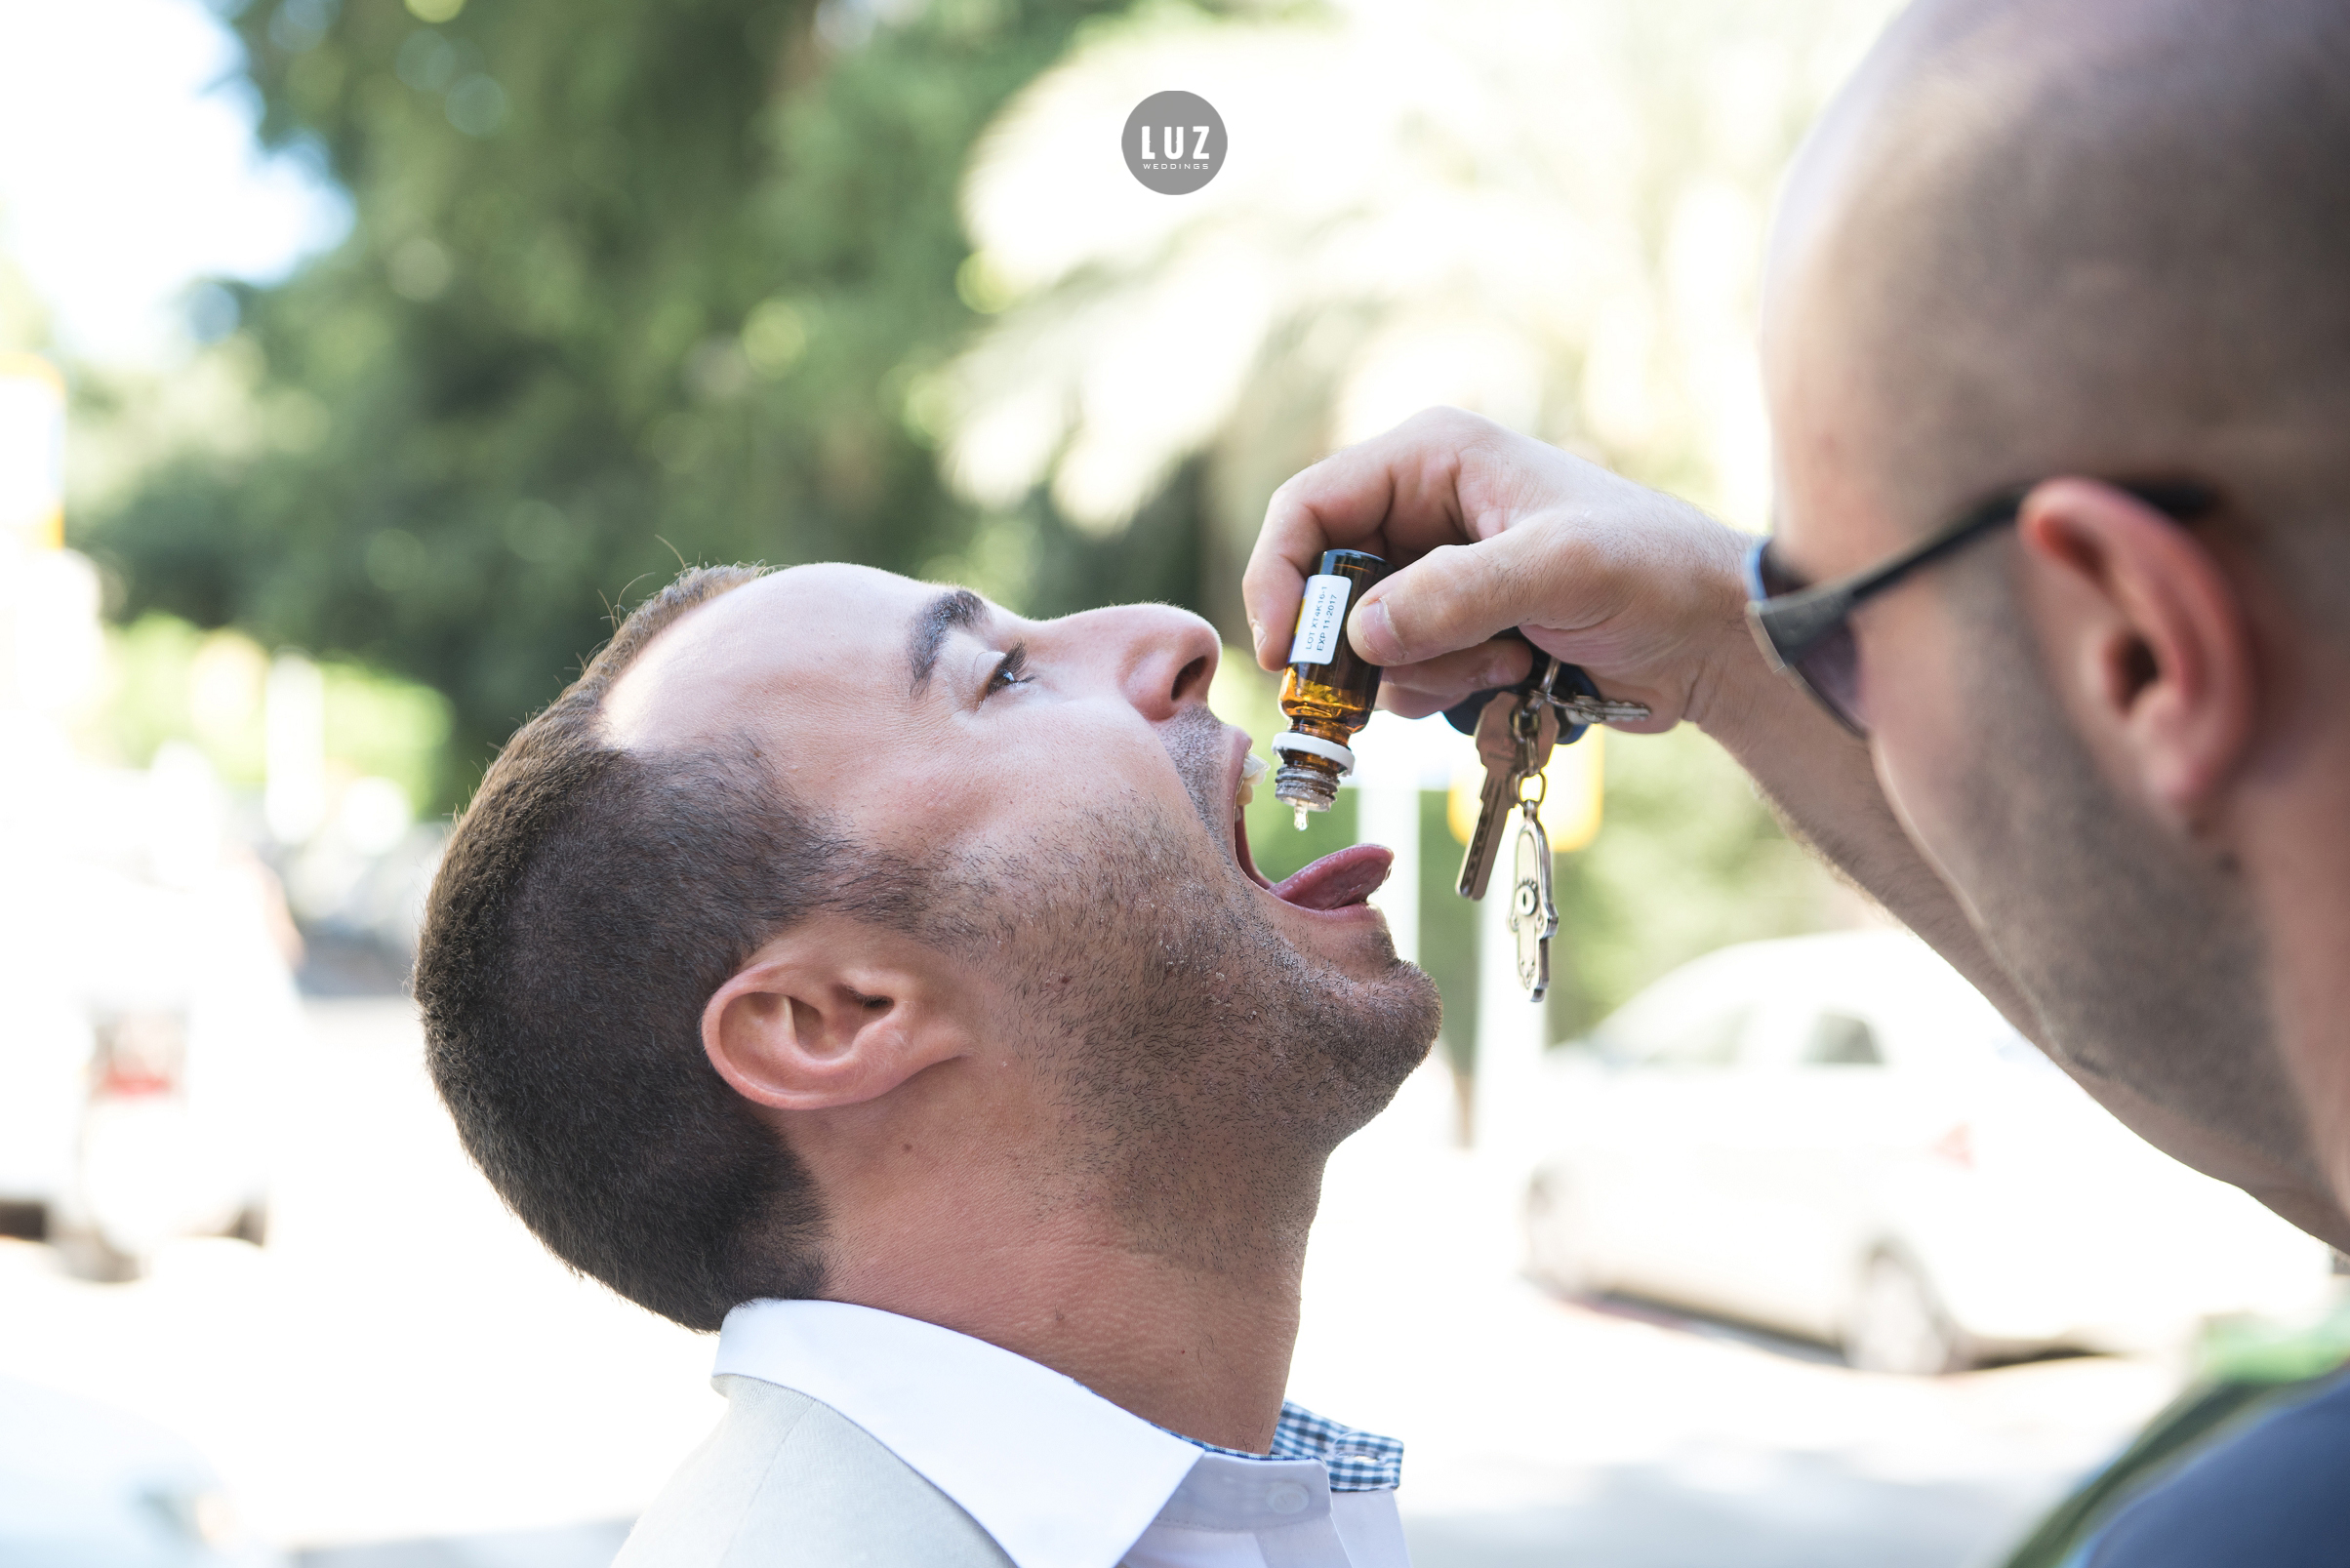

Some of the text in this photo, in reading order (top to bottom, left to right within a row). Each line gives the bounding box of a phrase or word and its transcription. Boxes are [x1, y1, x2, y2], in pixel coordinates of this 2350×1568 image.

[1306, 631, 1316, 650] LOT
[1317, 594, 1337, 651] EXP 11-2017
